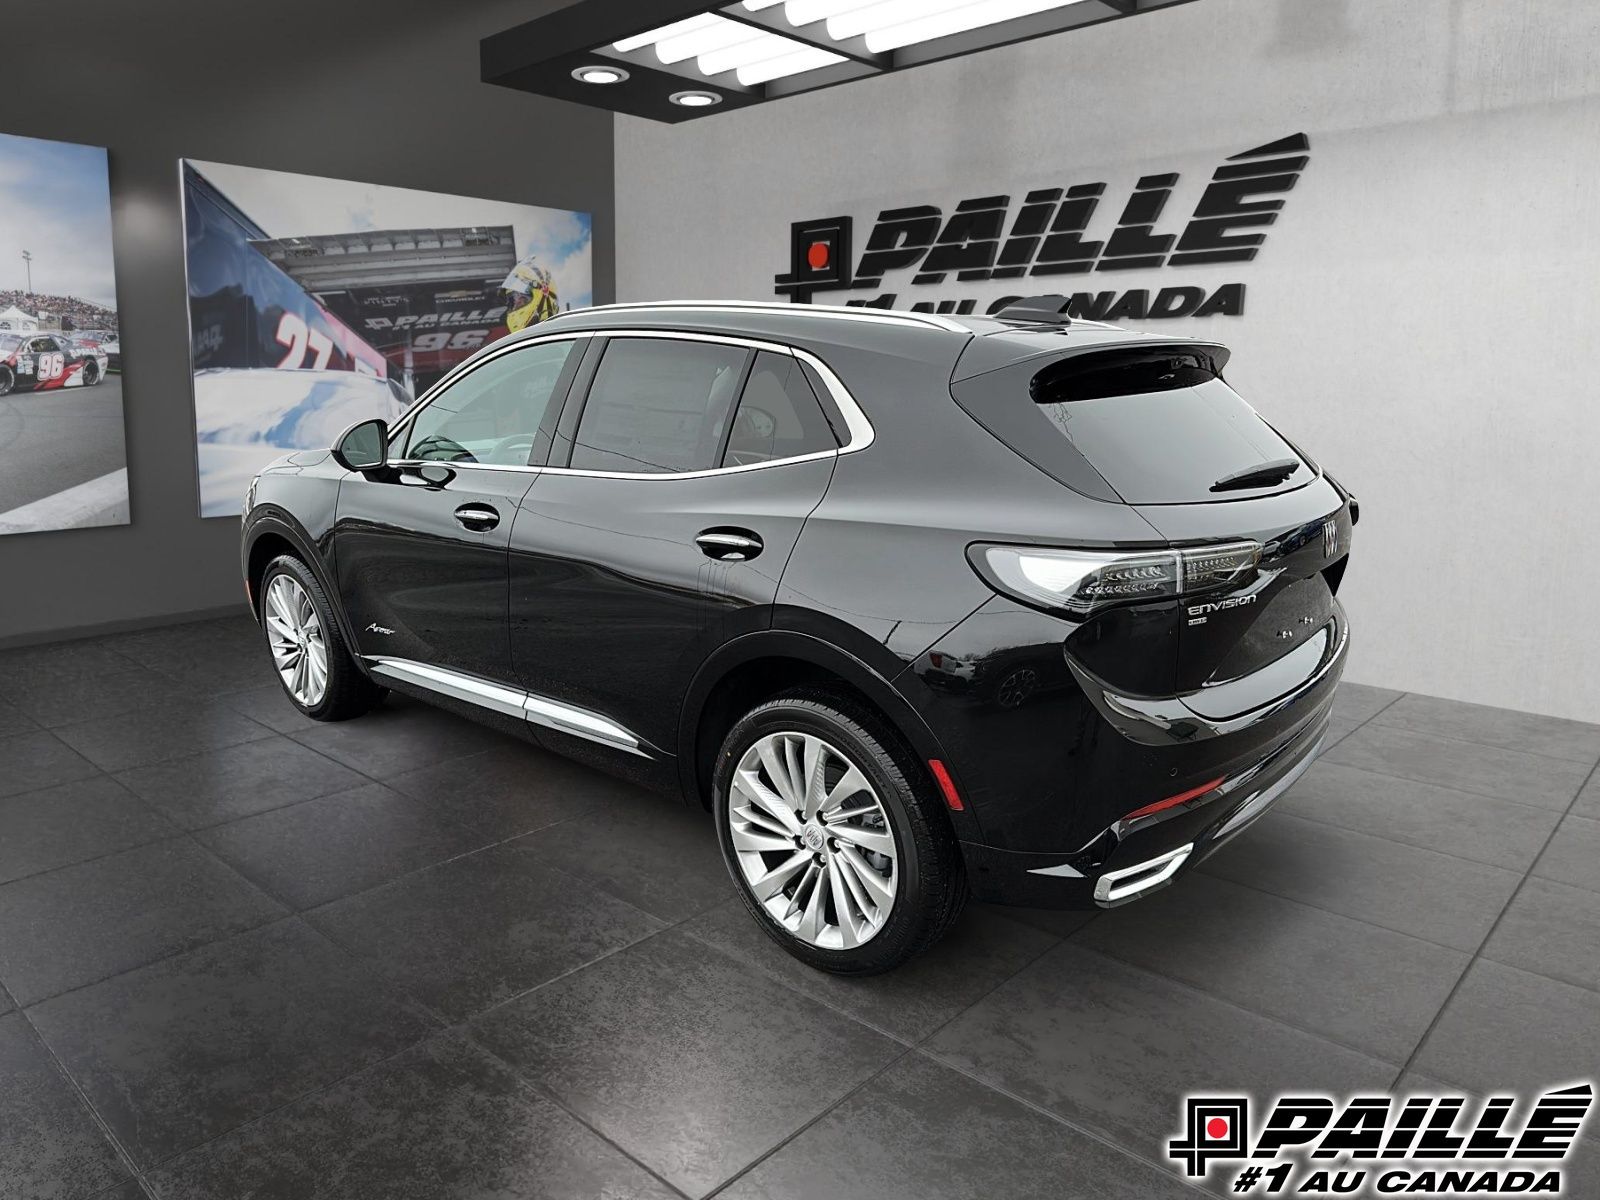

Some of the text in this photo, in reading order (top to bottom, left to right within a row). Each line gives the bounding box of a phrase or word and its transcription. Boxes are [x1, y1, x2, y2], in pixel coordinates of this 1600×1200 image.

[852, 132, 1311, 289] PAILLÉ
[985, 282, 1246, 320] NADA
[411, 329, 490, 352] 96
[37, 353, 64, 381] 96
[1187, 594, 1257, 616] ENVISION
